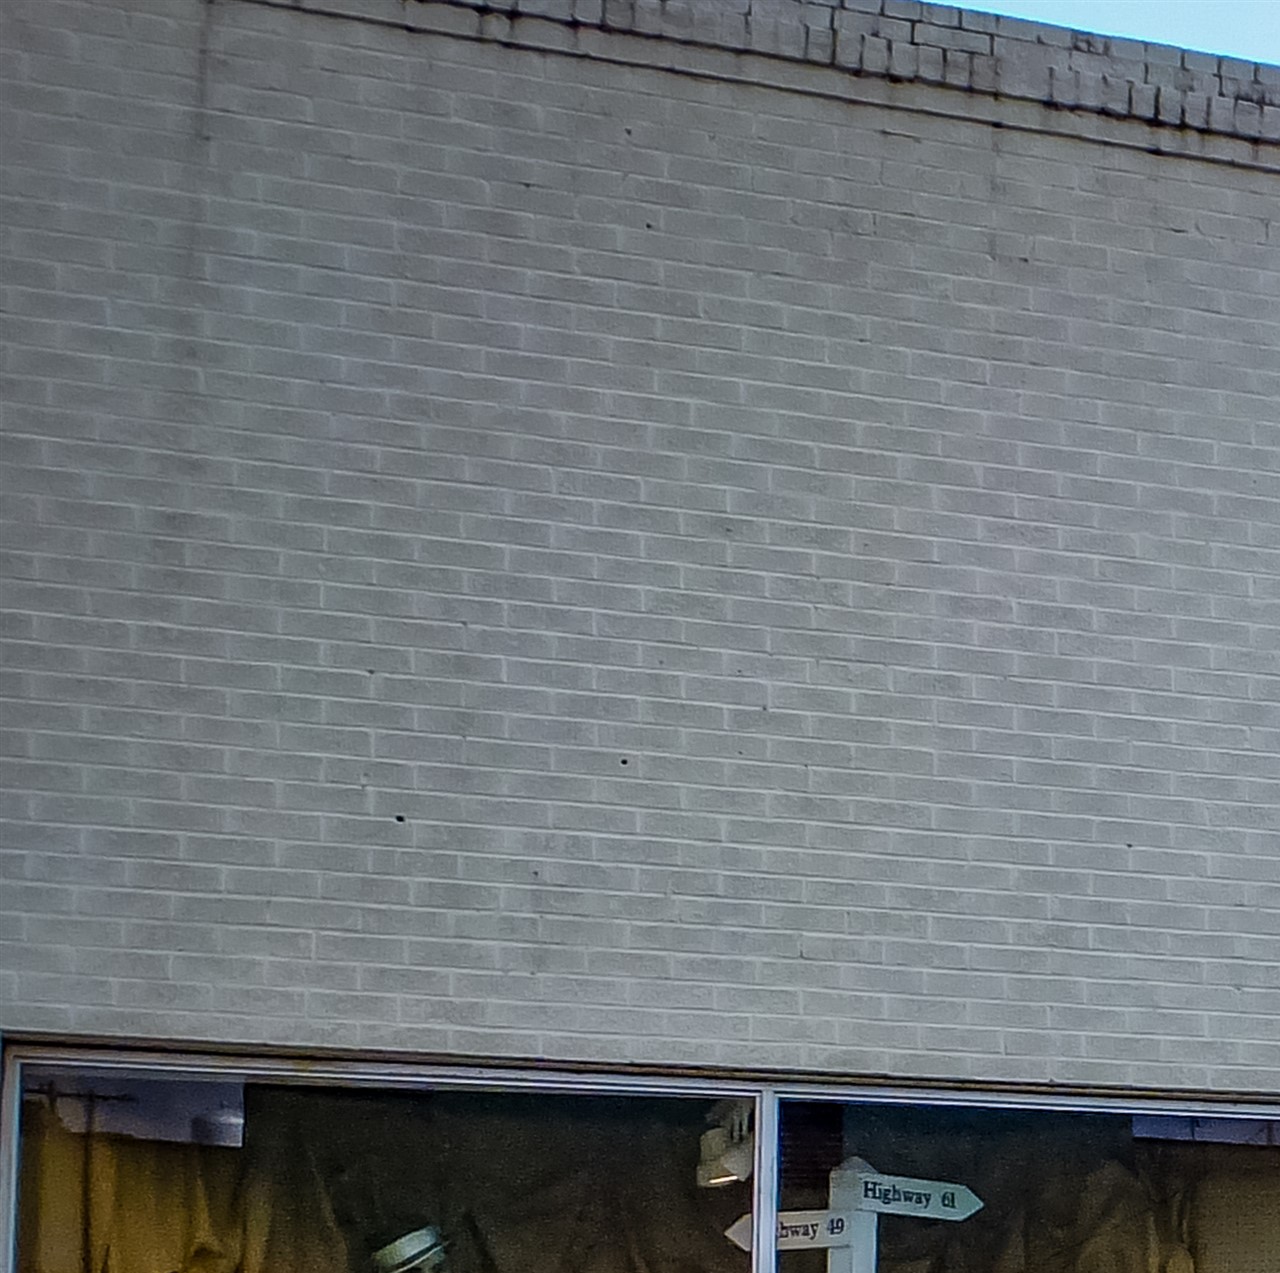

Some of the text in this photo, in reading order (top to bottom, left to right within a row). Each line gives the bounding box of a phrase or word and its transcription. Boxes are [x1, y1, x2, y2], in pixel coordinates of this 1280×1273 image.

[863, 1181, 956, 1209] Highway 61
[777, 1218, 845, 1240] hway 49
